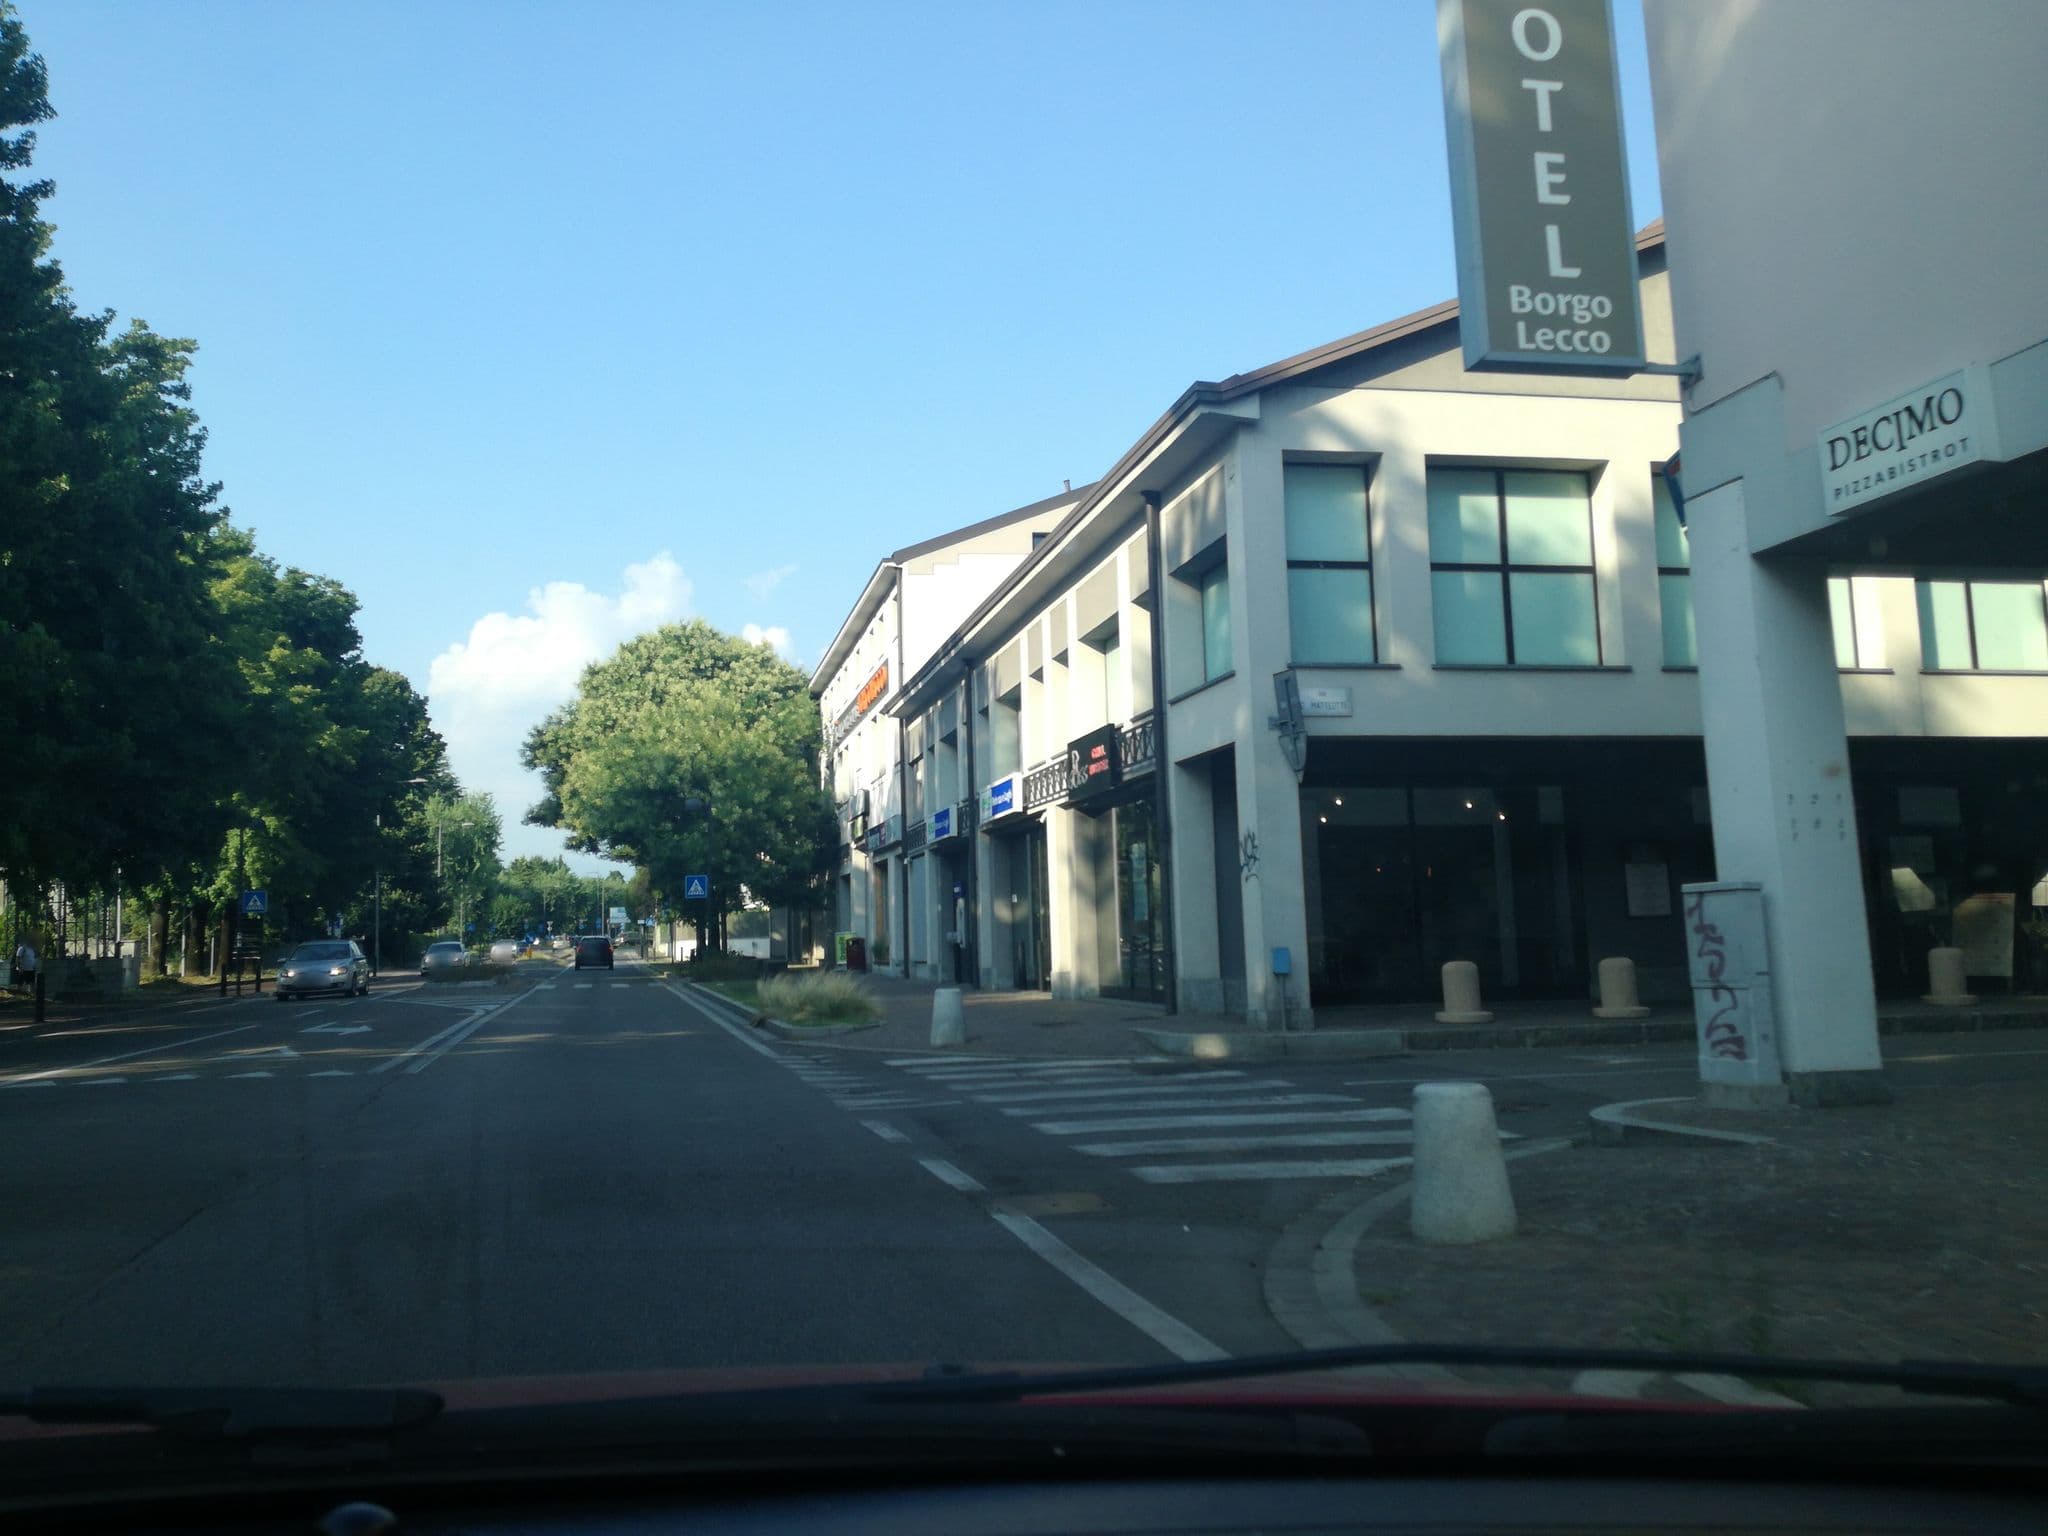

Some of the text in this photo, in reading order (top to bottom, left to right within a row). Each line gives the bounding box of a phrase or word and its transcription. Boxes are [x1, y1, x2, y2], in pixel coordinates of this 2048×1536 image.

[1510, 285, 1612, 324] Borgo
[1517, 321, 1611, 353] Lecco
[1827, 388, 1963, 471] DECIMO
[1834, 438, 1968, 500] PIZZABISTROT
